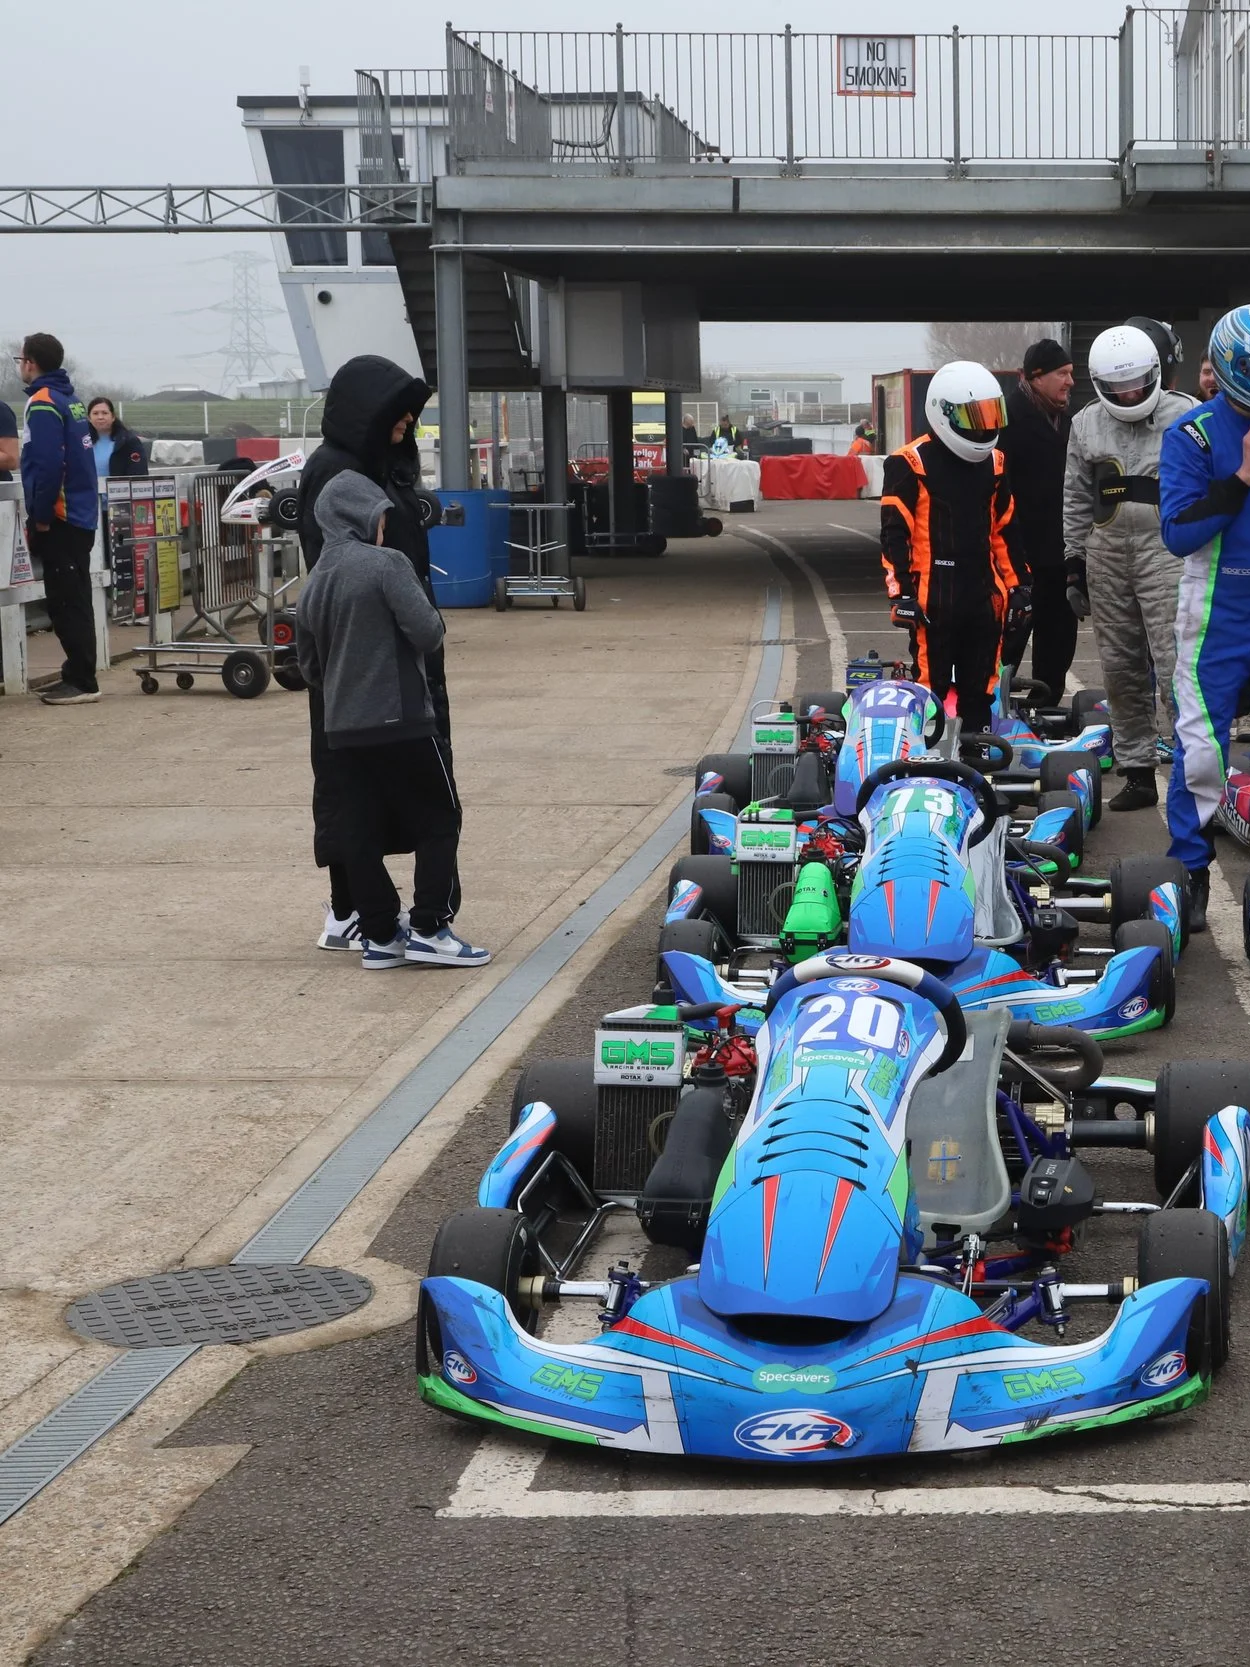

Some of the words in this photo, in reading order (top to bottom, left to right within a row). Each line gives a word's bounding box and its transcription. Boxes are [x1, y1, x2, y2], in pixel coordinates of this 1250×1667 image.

[866, 41, 886, 62] NO
[845, 66, 907, 86] SMOKING
[1183, 424, 1206, 449] sparco
[633, 448, 658, 460] rolley
[861, 687, 916, 709] 127
[755, 729, 795, 744] GMS
[890, 788, 954, 817] 73
[741, 830, 791, 847] GMS
[827, 954, 884, 965] CKR
[1035, 1000, 1086, 1021] GMS
[798, 995, 900, 1049] 20
[602, 1039, 675, 1067] GMS
[800, 1053, 866, 1066] Specsavers
[758, 1371, 831, 1384] Specsavers
[1146, 1358, 1185, 1380] CKR
[531, 1363, 605, 1403] GMS
[1002, 1365, 1086, 1402] GMS
